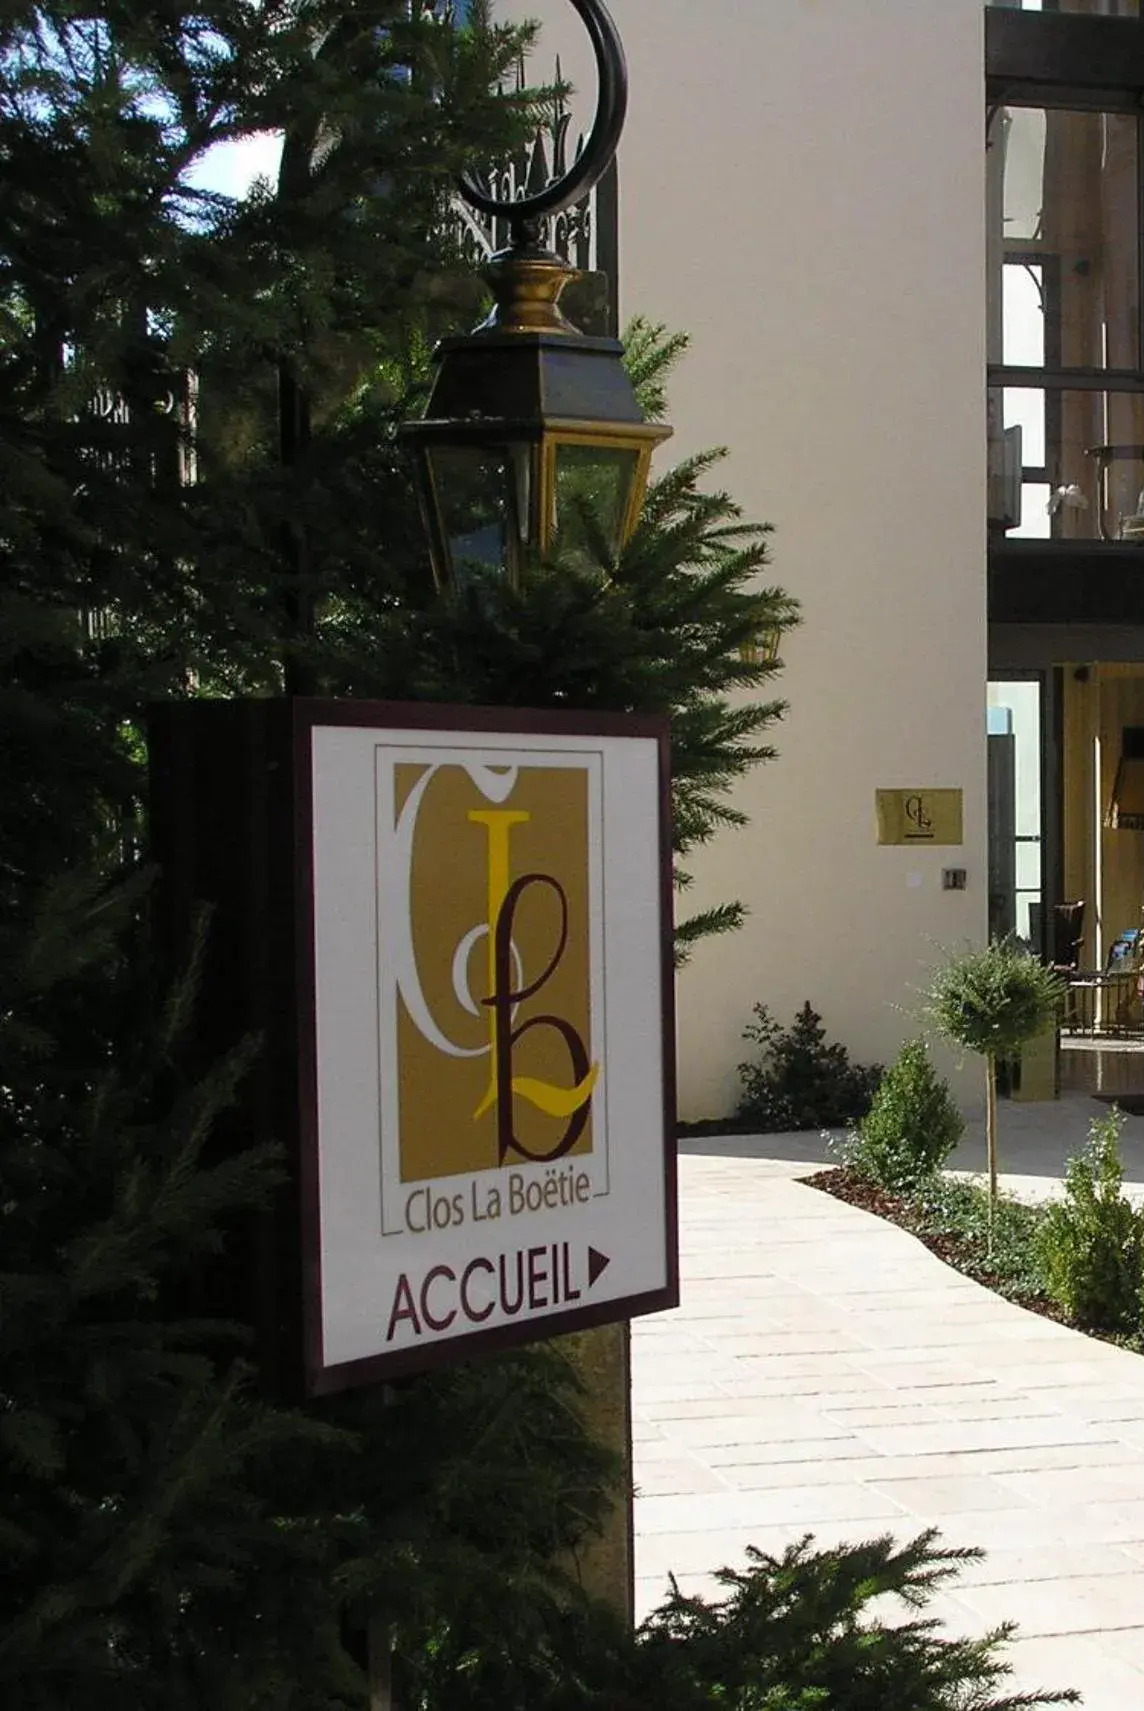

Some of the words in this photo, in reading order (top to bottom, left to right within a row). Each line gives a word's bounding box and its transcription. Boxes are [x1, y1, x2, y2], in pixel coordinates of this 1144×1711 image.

[405, 1185, 465, 1233] Clos
[471, 1180, 501, 1222] La
[509, 1164, 590, 1216] Boëtie
[386, 1241, 581, 1341] ACCUEIL
